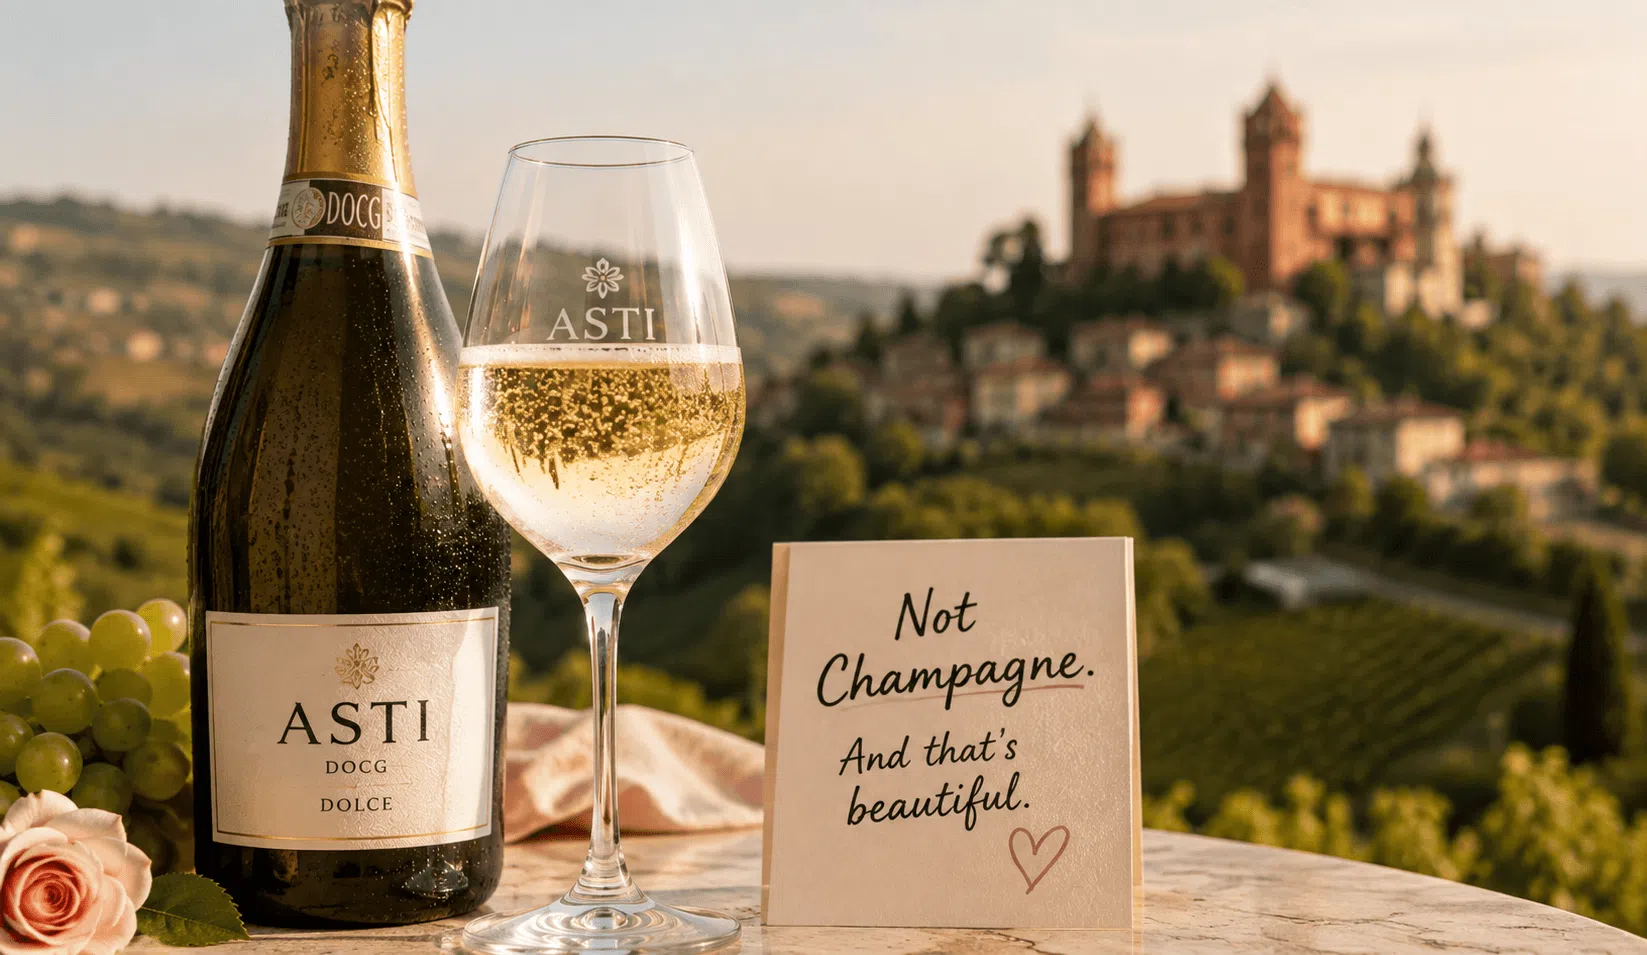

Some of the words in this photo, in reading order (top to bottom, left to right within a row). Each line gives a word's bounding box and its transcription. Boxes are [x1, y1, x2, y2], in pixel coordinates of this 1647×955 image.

[326, 191, 381, 230] DOCG
[546, 307, 656, 341] ASTI
[895, 587, 978, 641] Not
[817, 652, 1095, 711] Champagne.
[277, 700, 430, 745] ASTI
[325, 759, 388, 774] DOCG
[839, 735, 911, 776] And
[924, 728, 1018, 767] that's
[320, 796, 393, 812] DOLCE
[847, 771, 1030, 832] beautiful.
